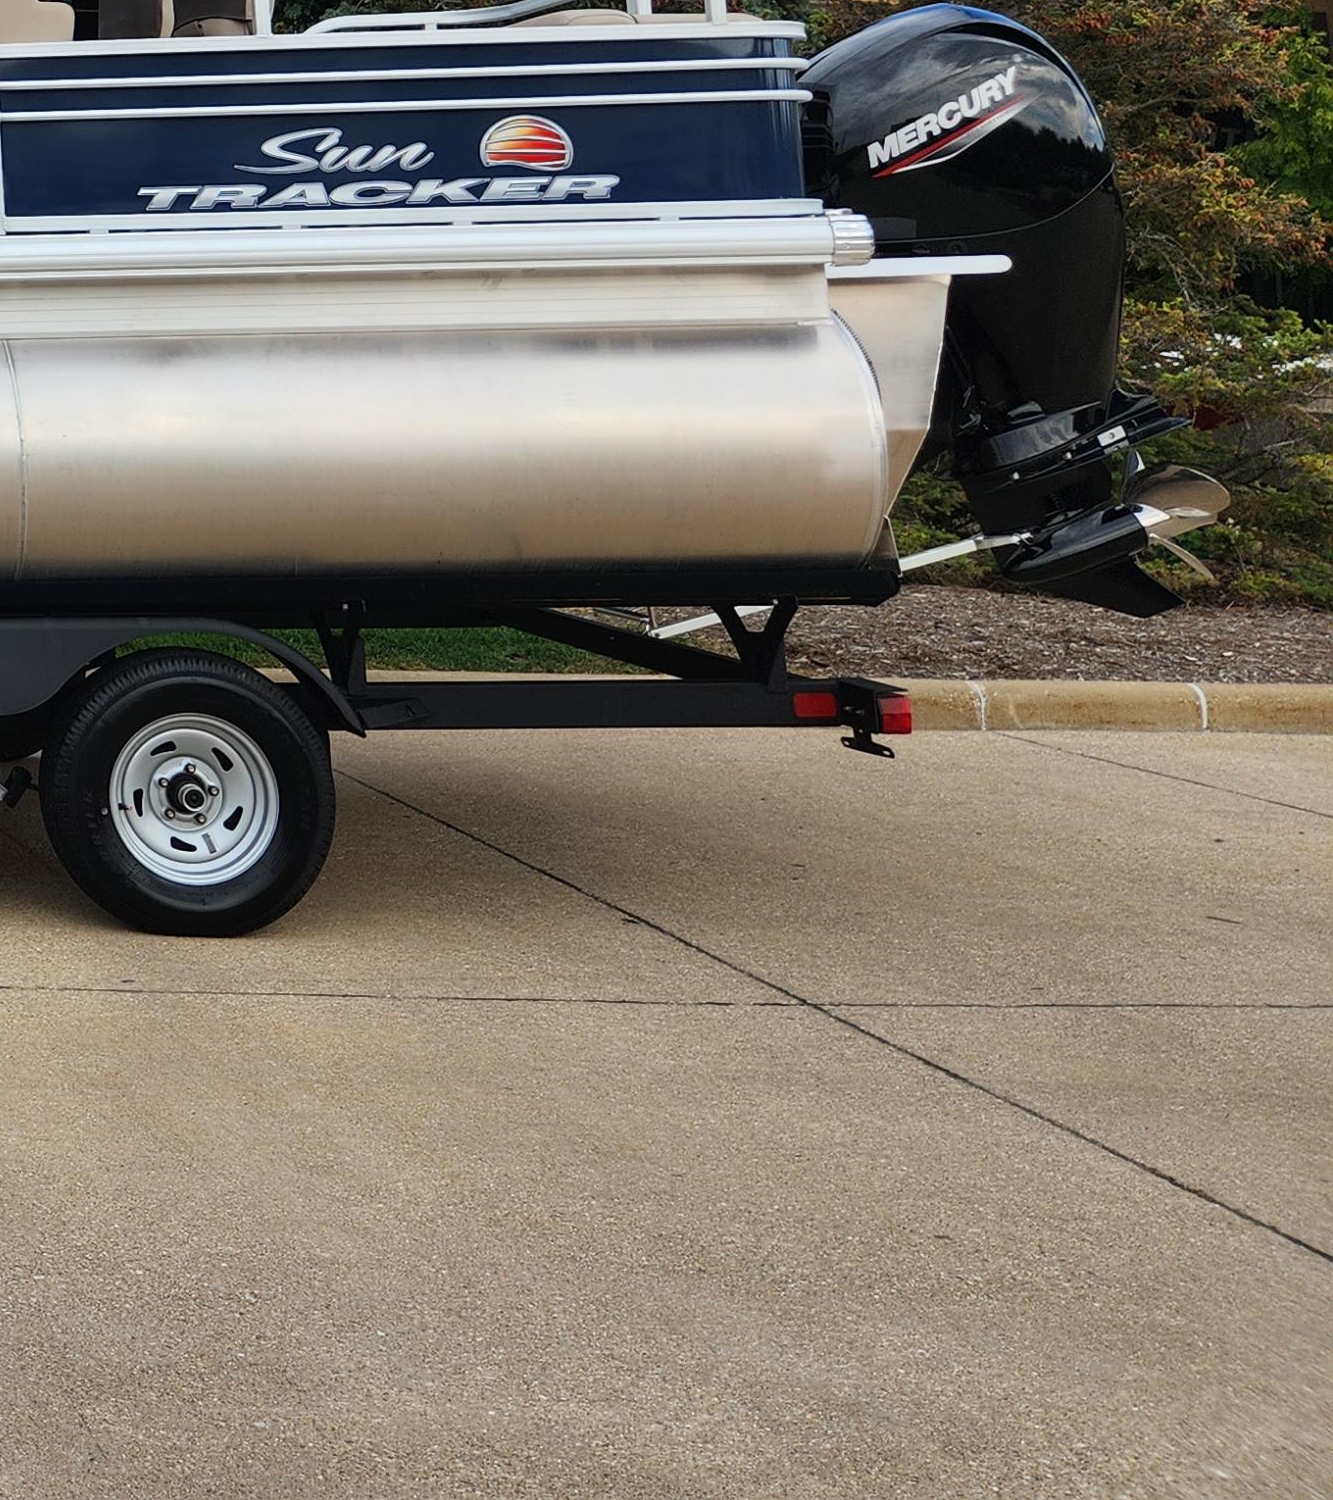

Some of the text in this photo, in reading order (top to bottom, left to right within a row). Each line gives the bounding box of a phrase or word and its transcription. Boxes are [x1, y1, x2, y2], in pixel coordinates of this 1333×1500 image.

[866, 66, 1018, 170] MERCURY
[233, 126, 435, 175] Sun
[136, 173, 622, 212] TRACKER
